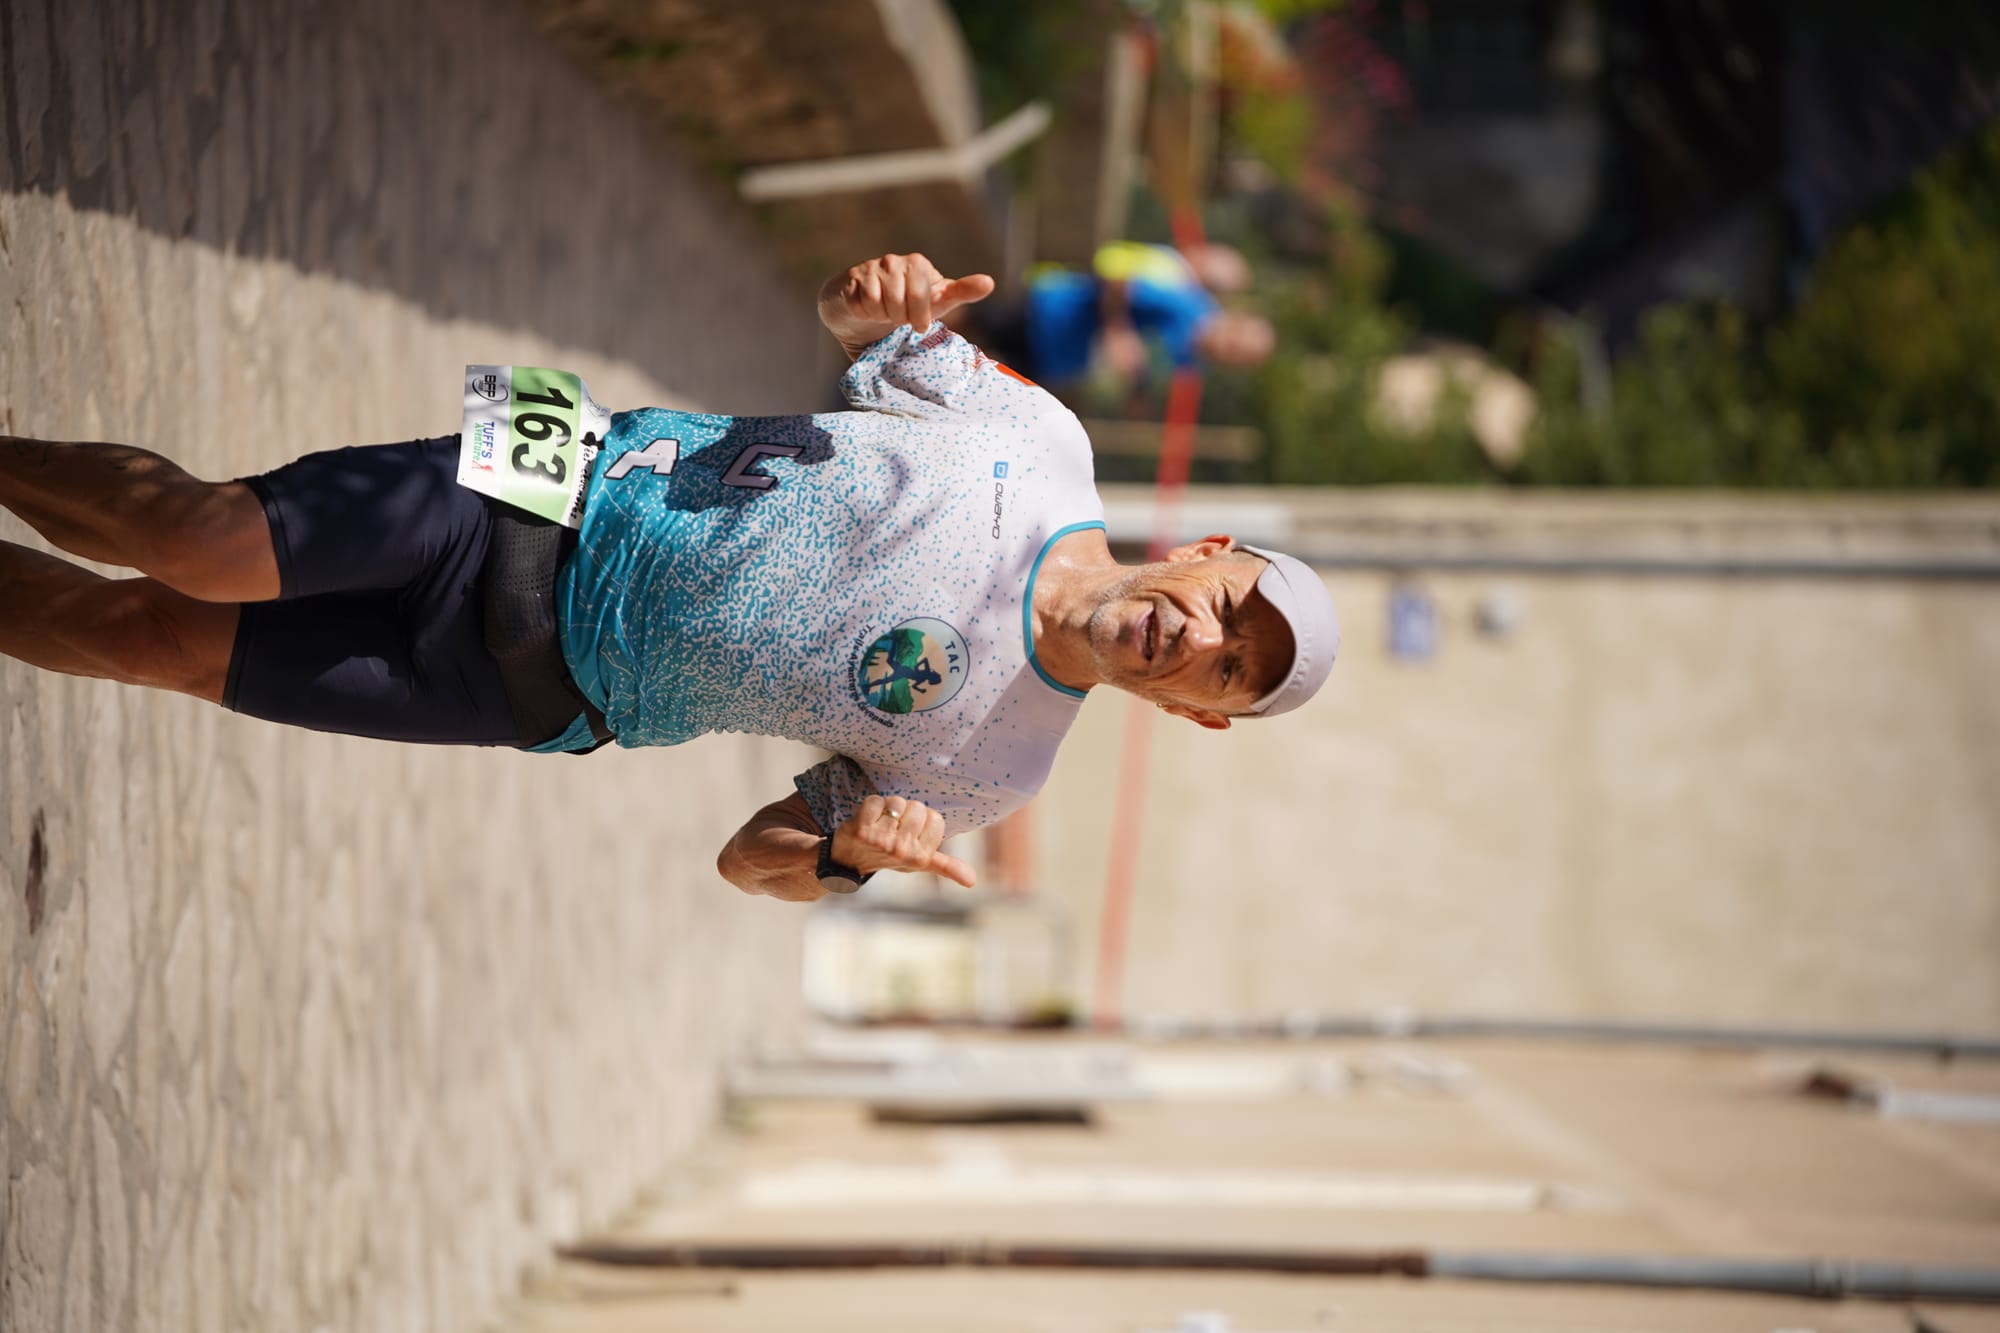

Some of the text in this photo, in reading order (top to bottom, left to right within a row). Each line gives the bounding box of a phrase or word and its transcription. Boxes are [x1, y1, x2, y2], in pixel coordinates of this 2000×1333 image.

[481, 421, 495, 460] TUFF'S
[511, 386, 574, 486] 163
[991, 482, 1004, 540] owayo
[944, 641, 960, 674] TAC
